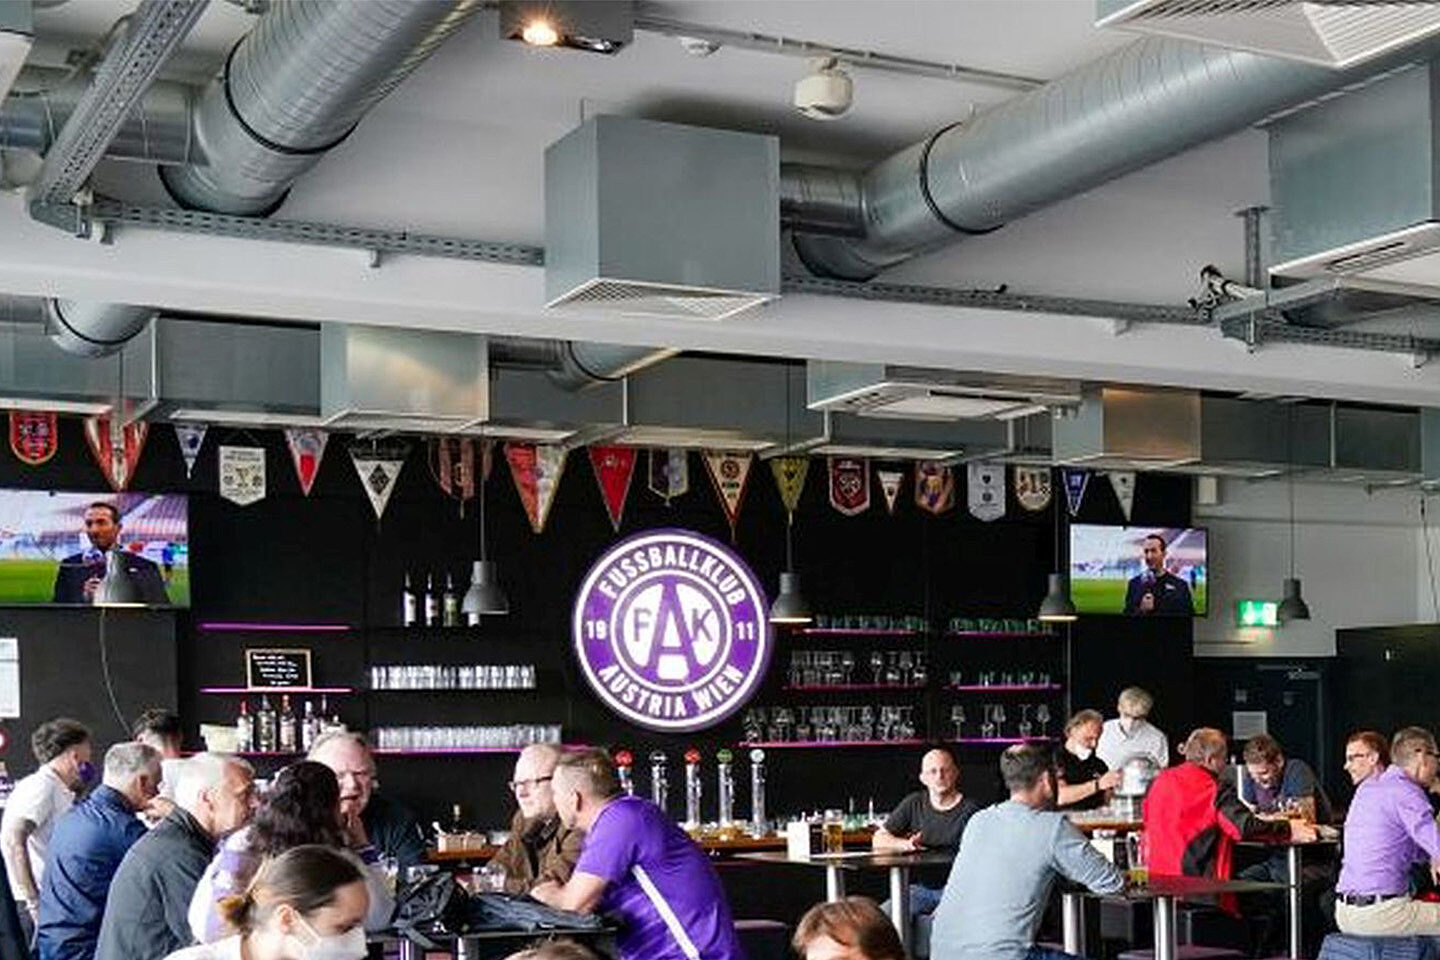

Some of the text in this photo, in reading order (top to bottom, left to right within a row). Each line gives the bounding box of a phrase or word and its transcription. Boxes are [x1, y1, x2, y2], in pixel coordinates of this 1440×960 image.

[598, 545, 747, 606] FUSSBALLKLUB
[587, 620, 755, 641] 19 11
[598, 664, 744, 717] AUSTRIA WIEN
